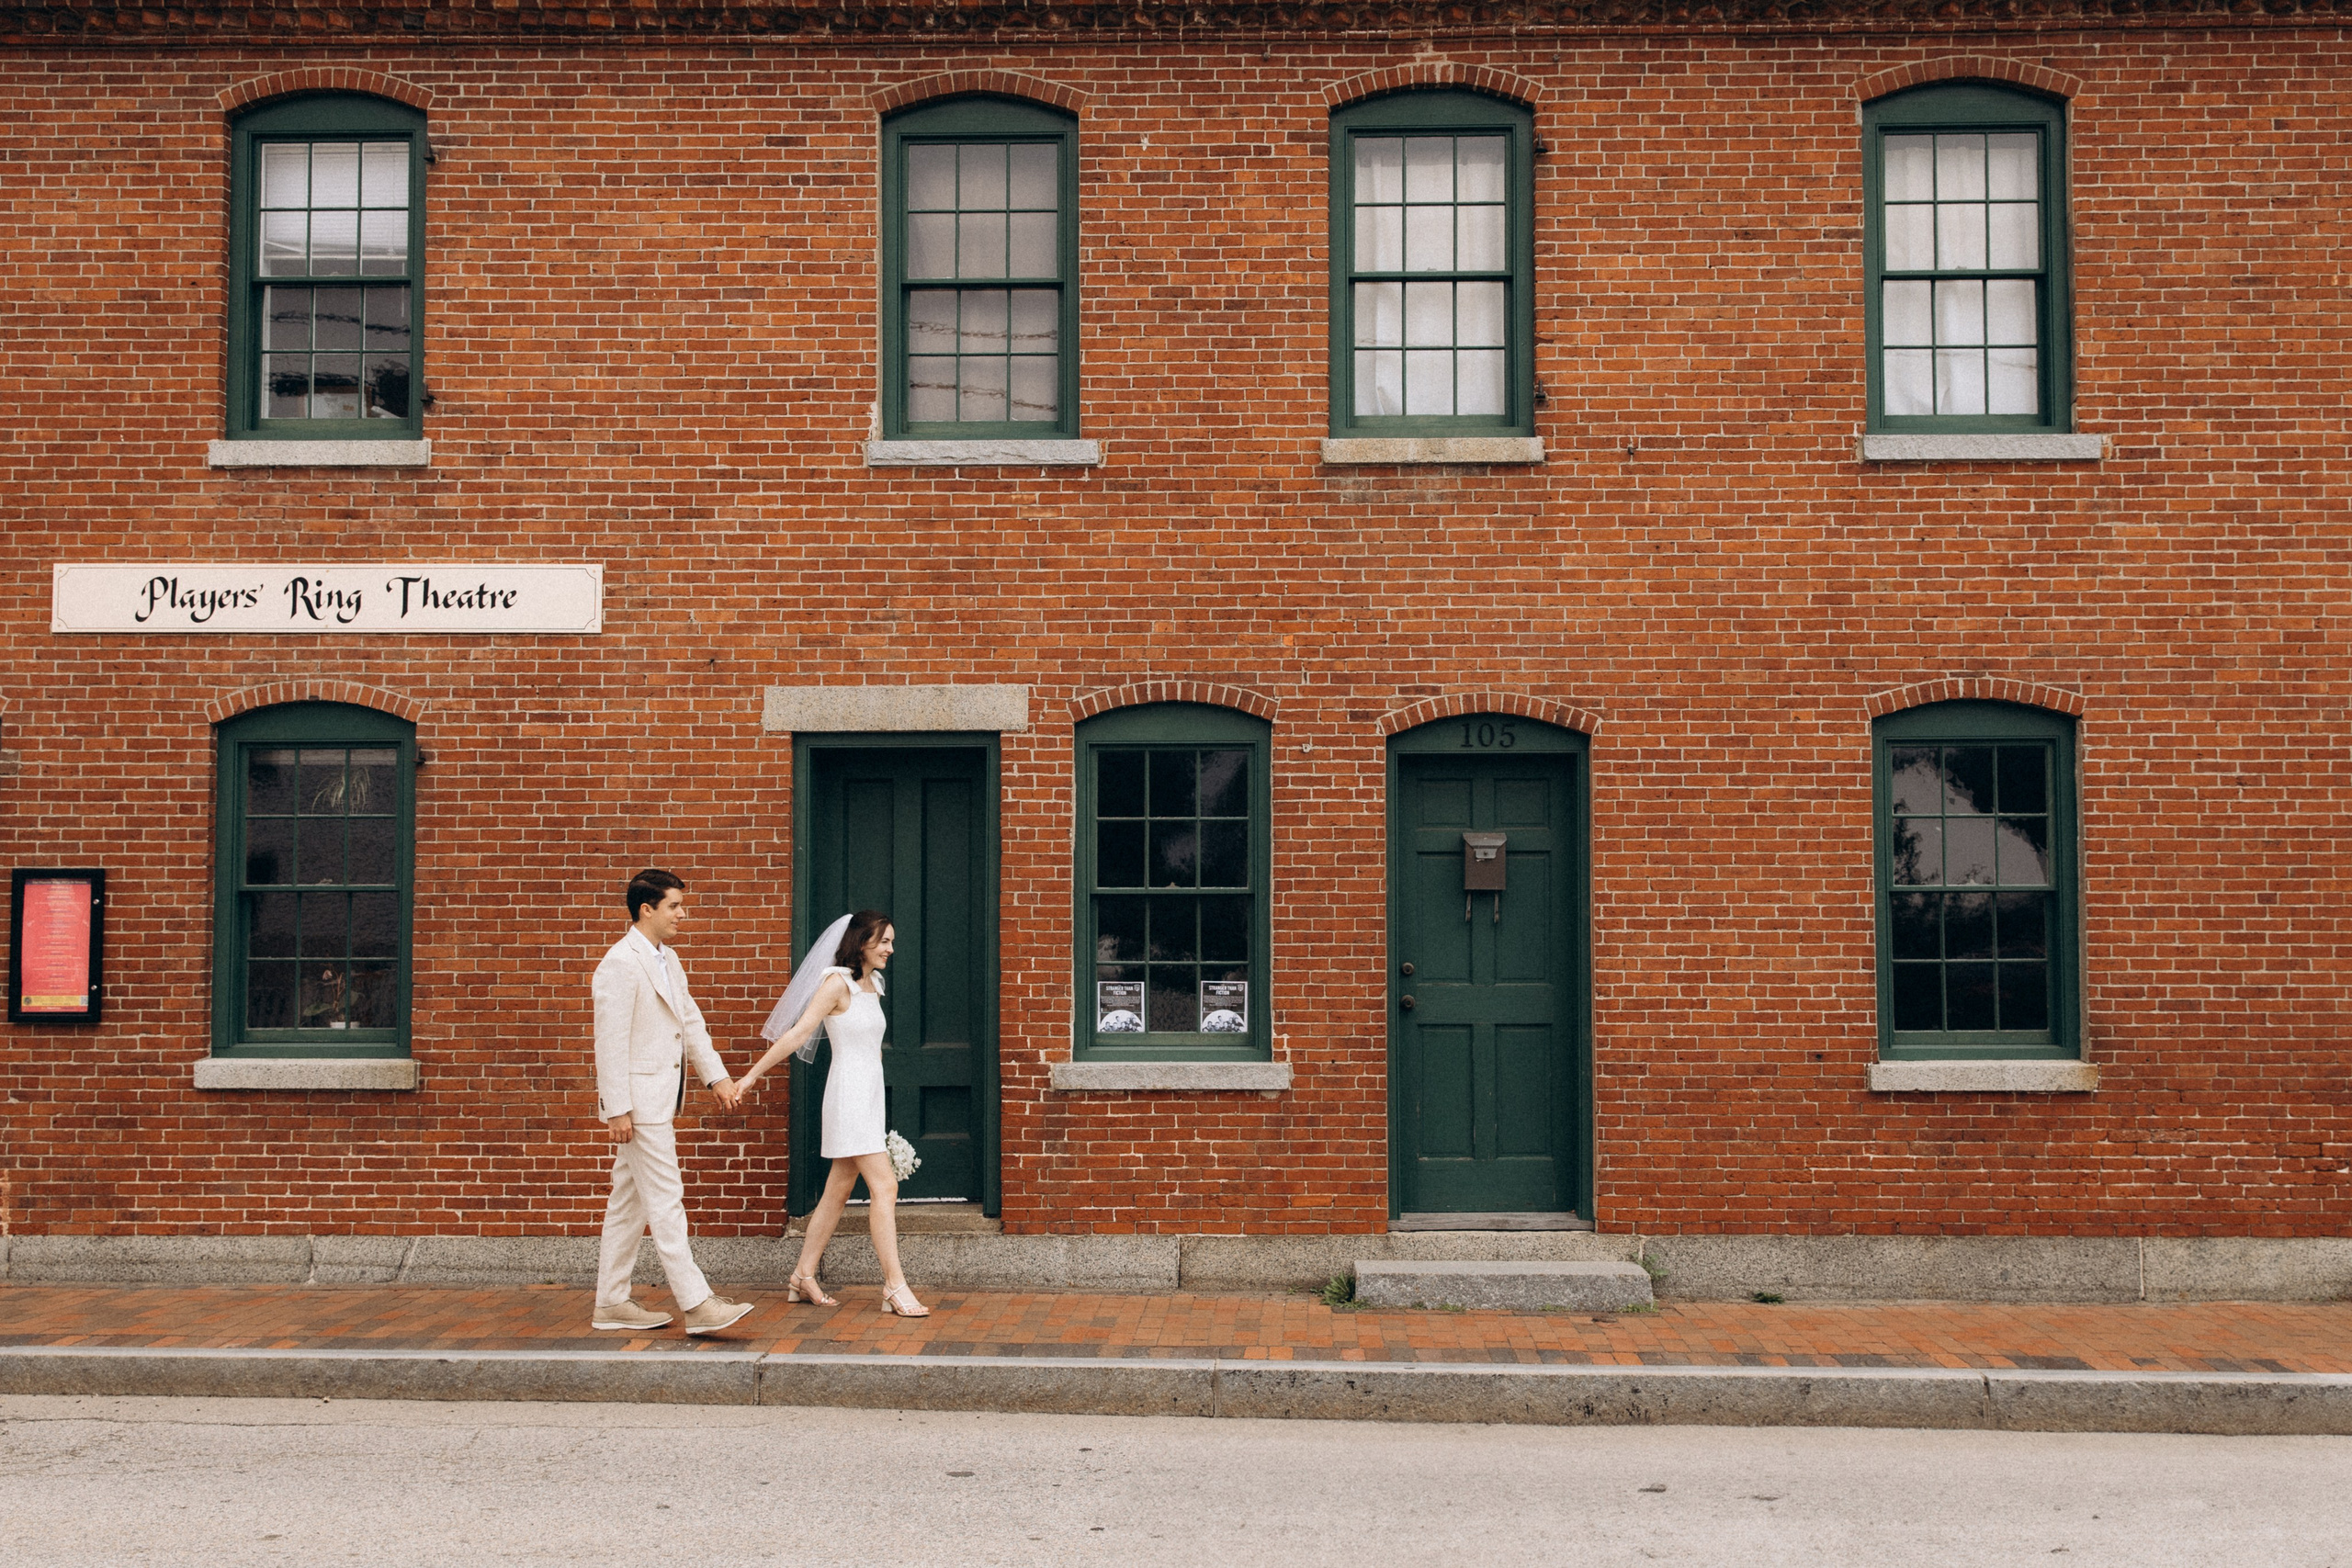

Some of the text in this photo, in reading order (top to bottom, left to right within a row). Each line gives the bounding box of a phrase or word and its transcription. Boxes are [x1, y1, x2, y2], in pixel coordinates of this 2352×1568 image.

[134, 575, 517, 623] Players' Ring Theatre
[1460, 722, 1516, 748] 105
